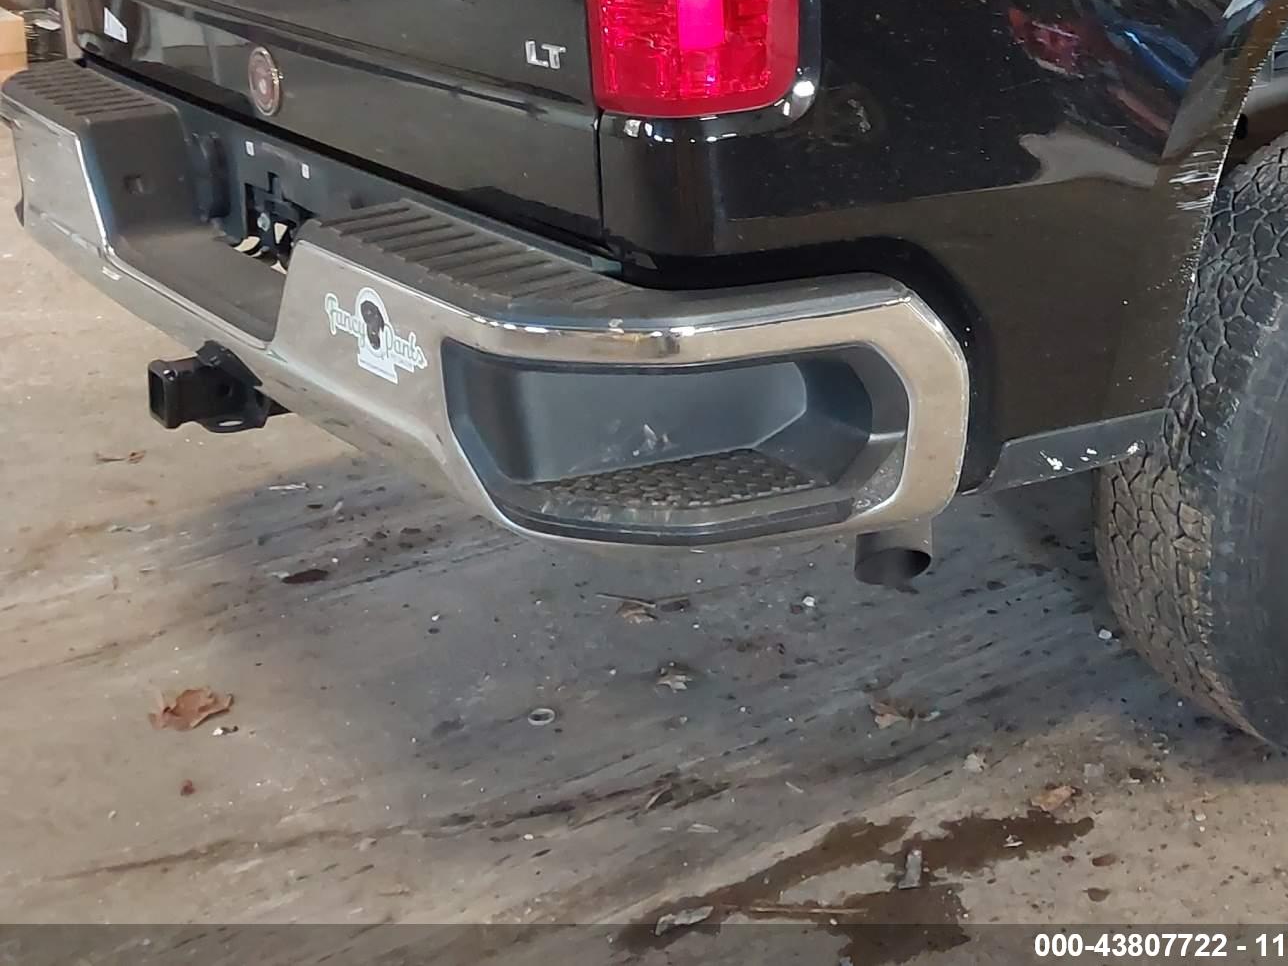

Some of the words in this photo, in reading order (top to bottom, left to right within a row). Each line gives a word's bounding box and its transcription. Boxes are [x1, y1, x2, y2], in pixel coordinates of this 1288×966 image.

[524, 40, 567, 70] LT
[324, 292, 366, 349] Fancy
[383, 322, 428, 369] Pants
